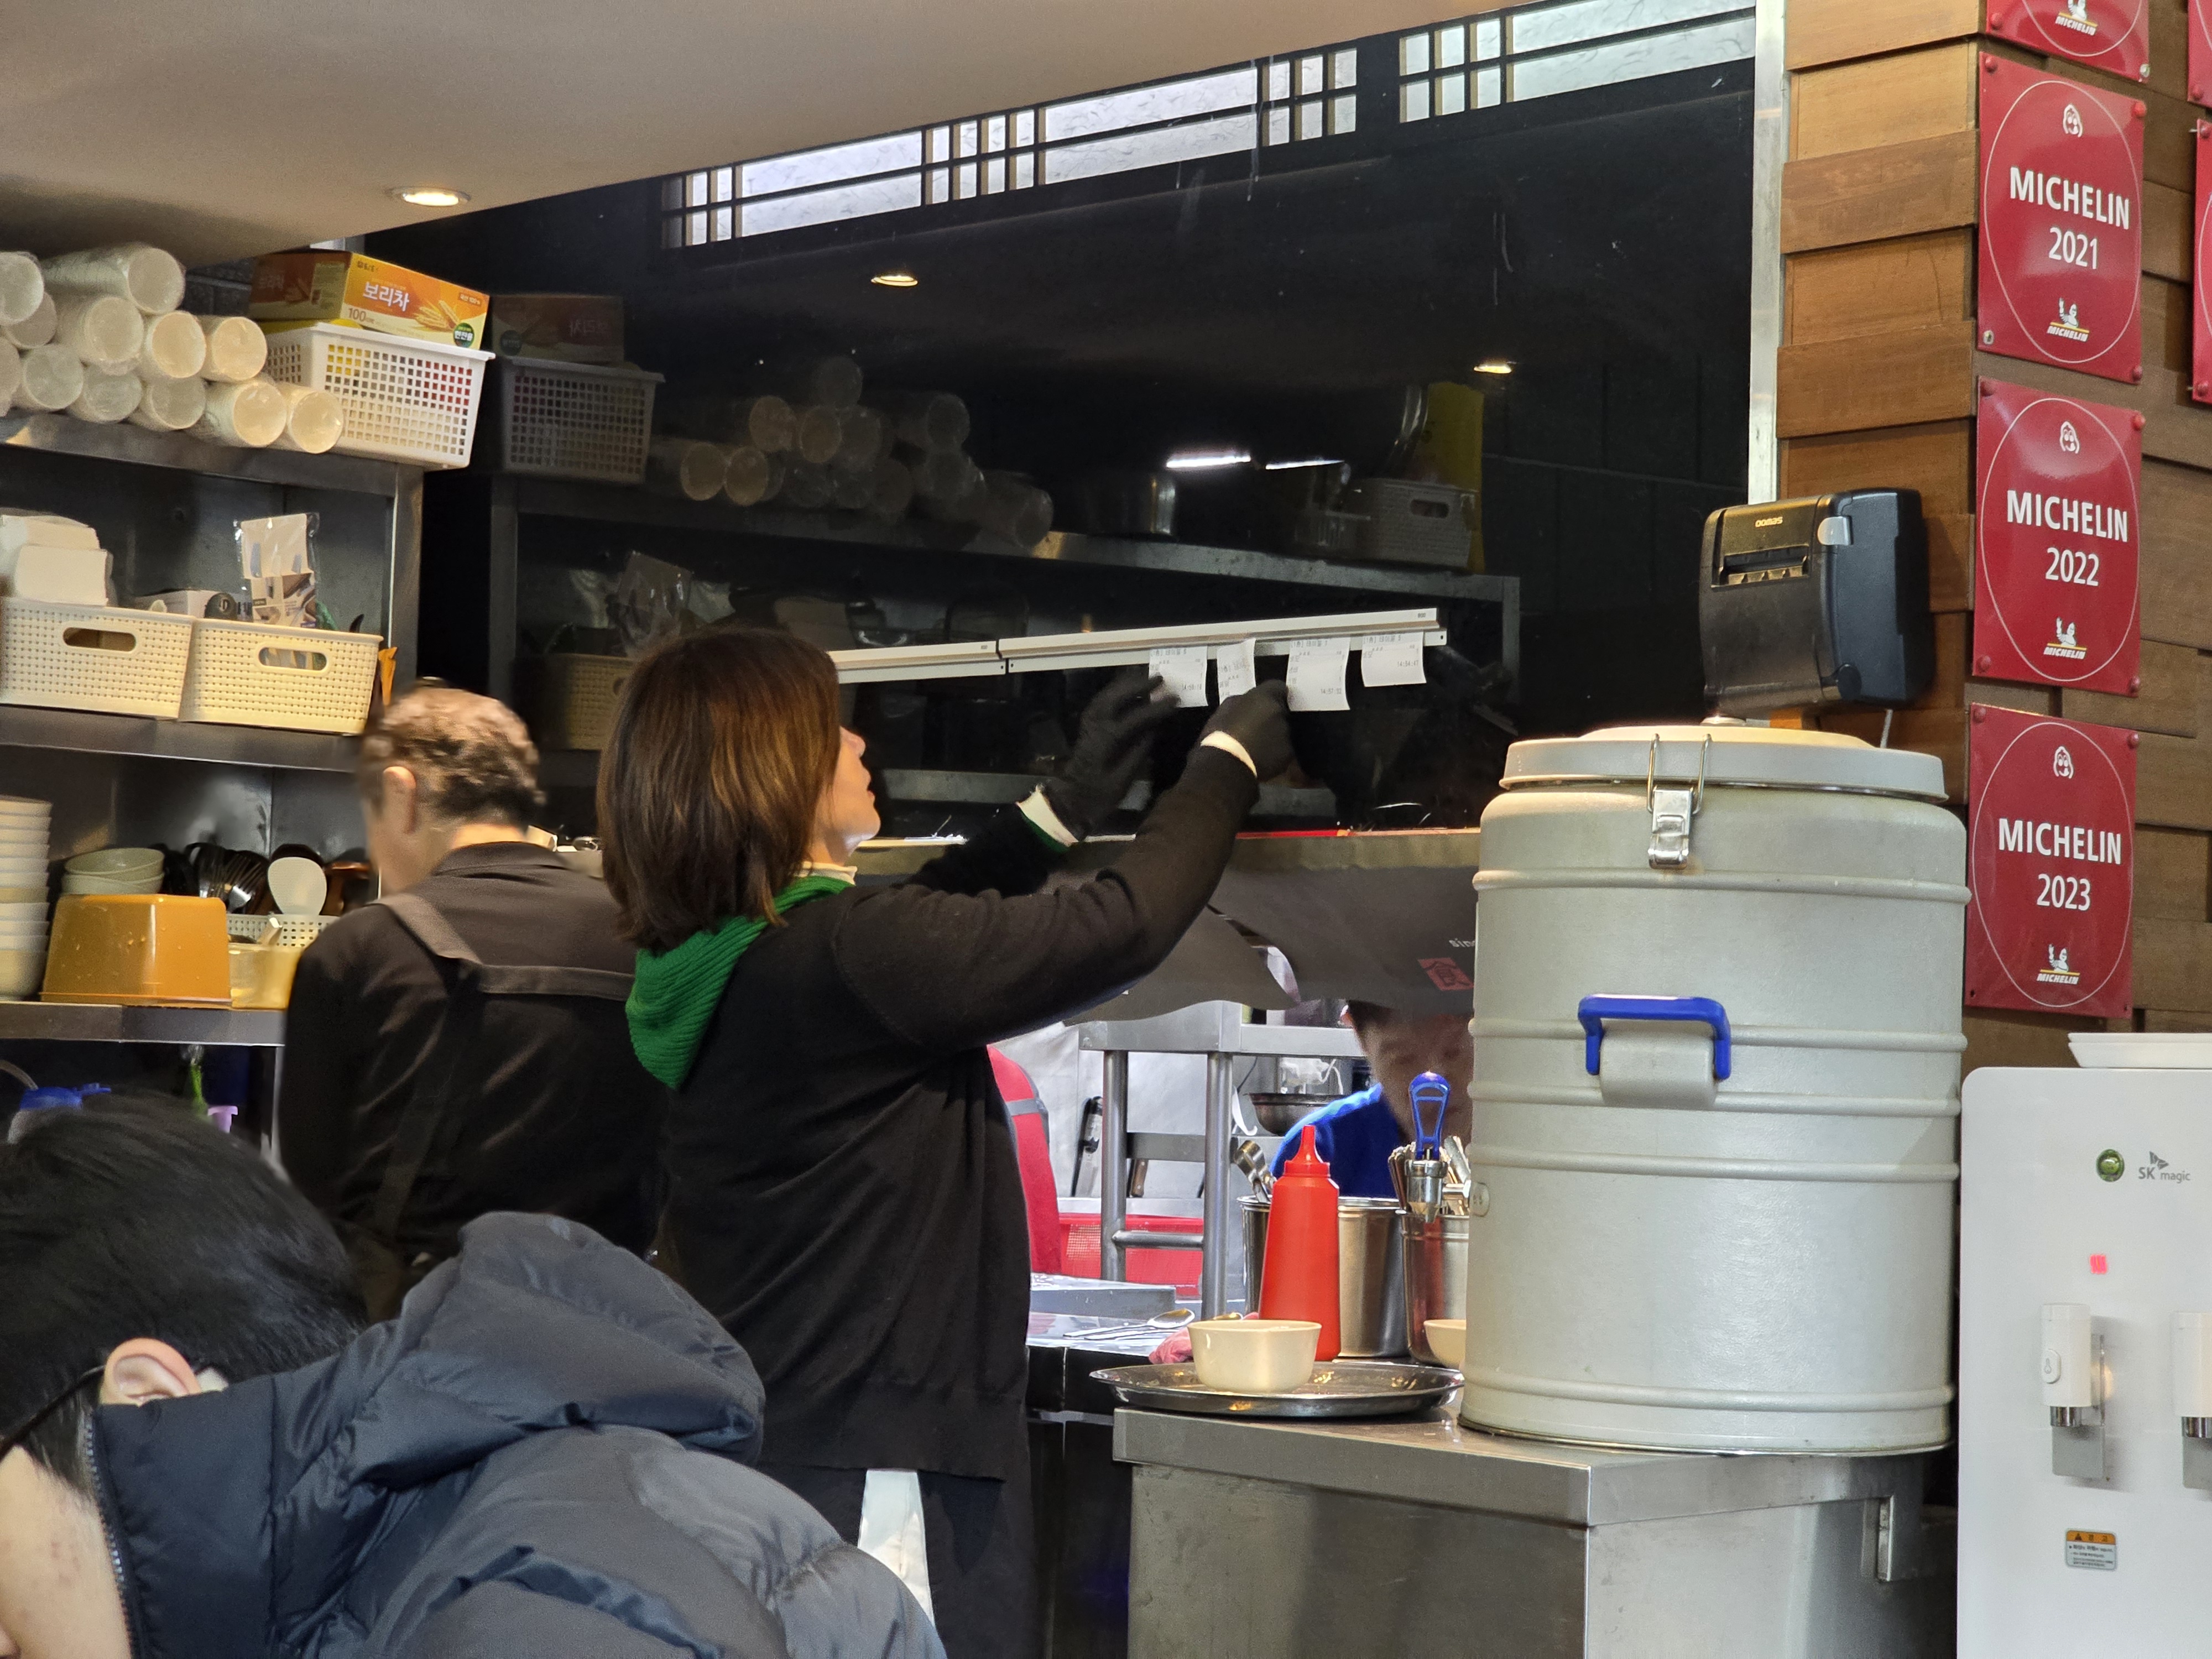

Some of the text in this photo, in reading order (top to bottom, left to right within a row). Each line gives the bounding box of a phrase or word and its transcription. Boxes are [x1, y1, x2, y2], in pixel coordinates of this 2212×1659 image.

[2055, 16, 2096, 36] MICHELIN
[2010, 166, 2130, 230] MICHELIN
[2048, 227, 2099, 269] 2021
[362, 281, 410, 312] 보리차
[348, 307, 367, 322] 100
[2047, 325, 2089, 342] MICHELIN
[2007, 490, 2128, 542] MICHELIN
[2045, 547, 2099, 587] 2022
[2043, 646, 2086, 660] MICHELIN
[1999, 818, 2122, 865] MICHELIN
[2036, 874, 2091, 911] 2023
[2036, 973, 2079, 985] MICHELIN
[2138, 1166, 2191, 1184] SK magic
